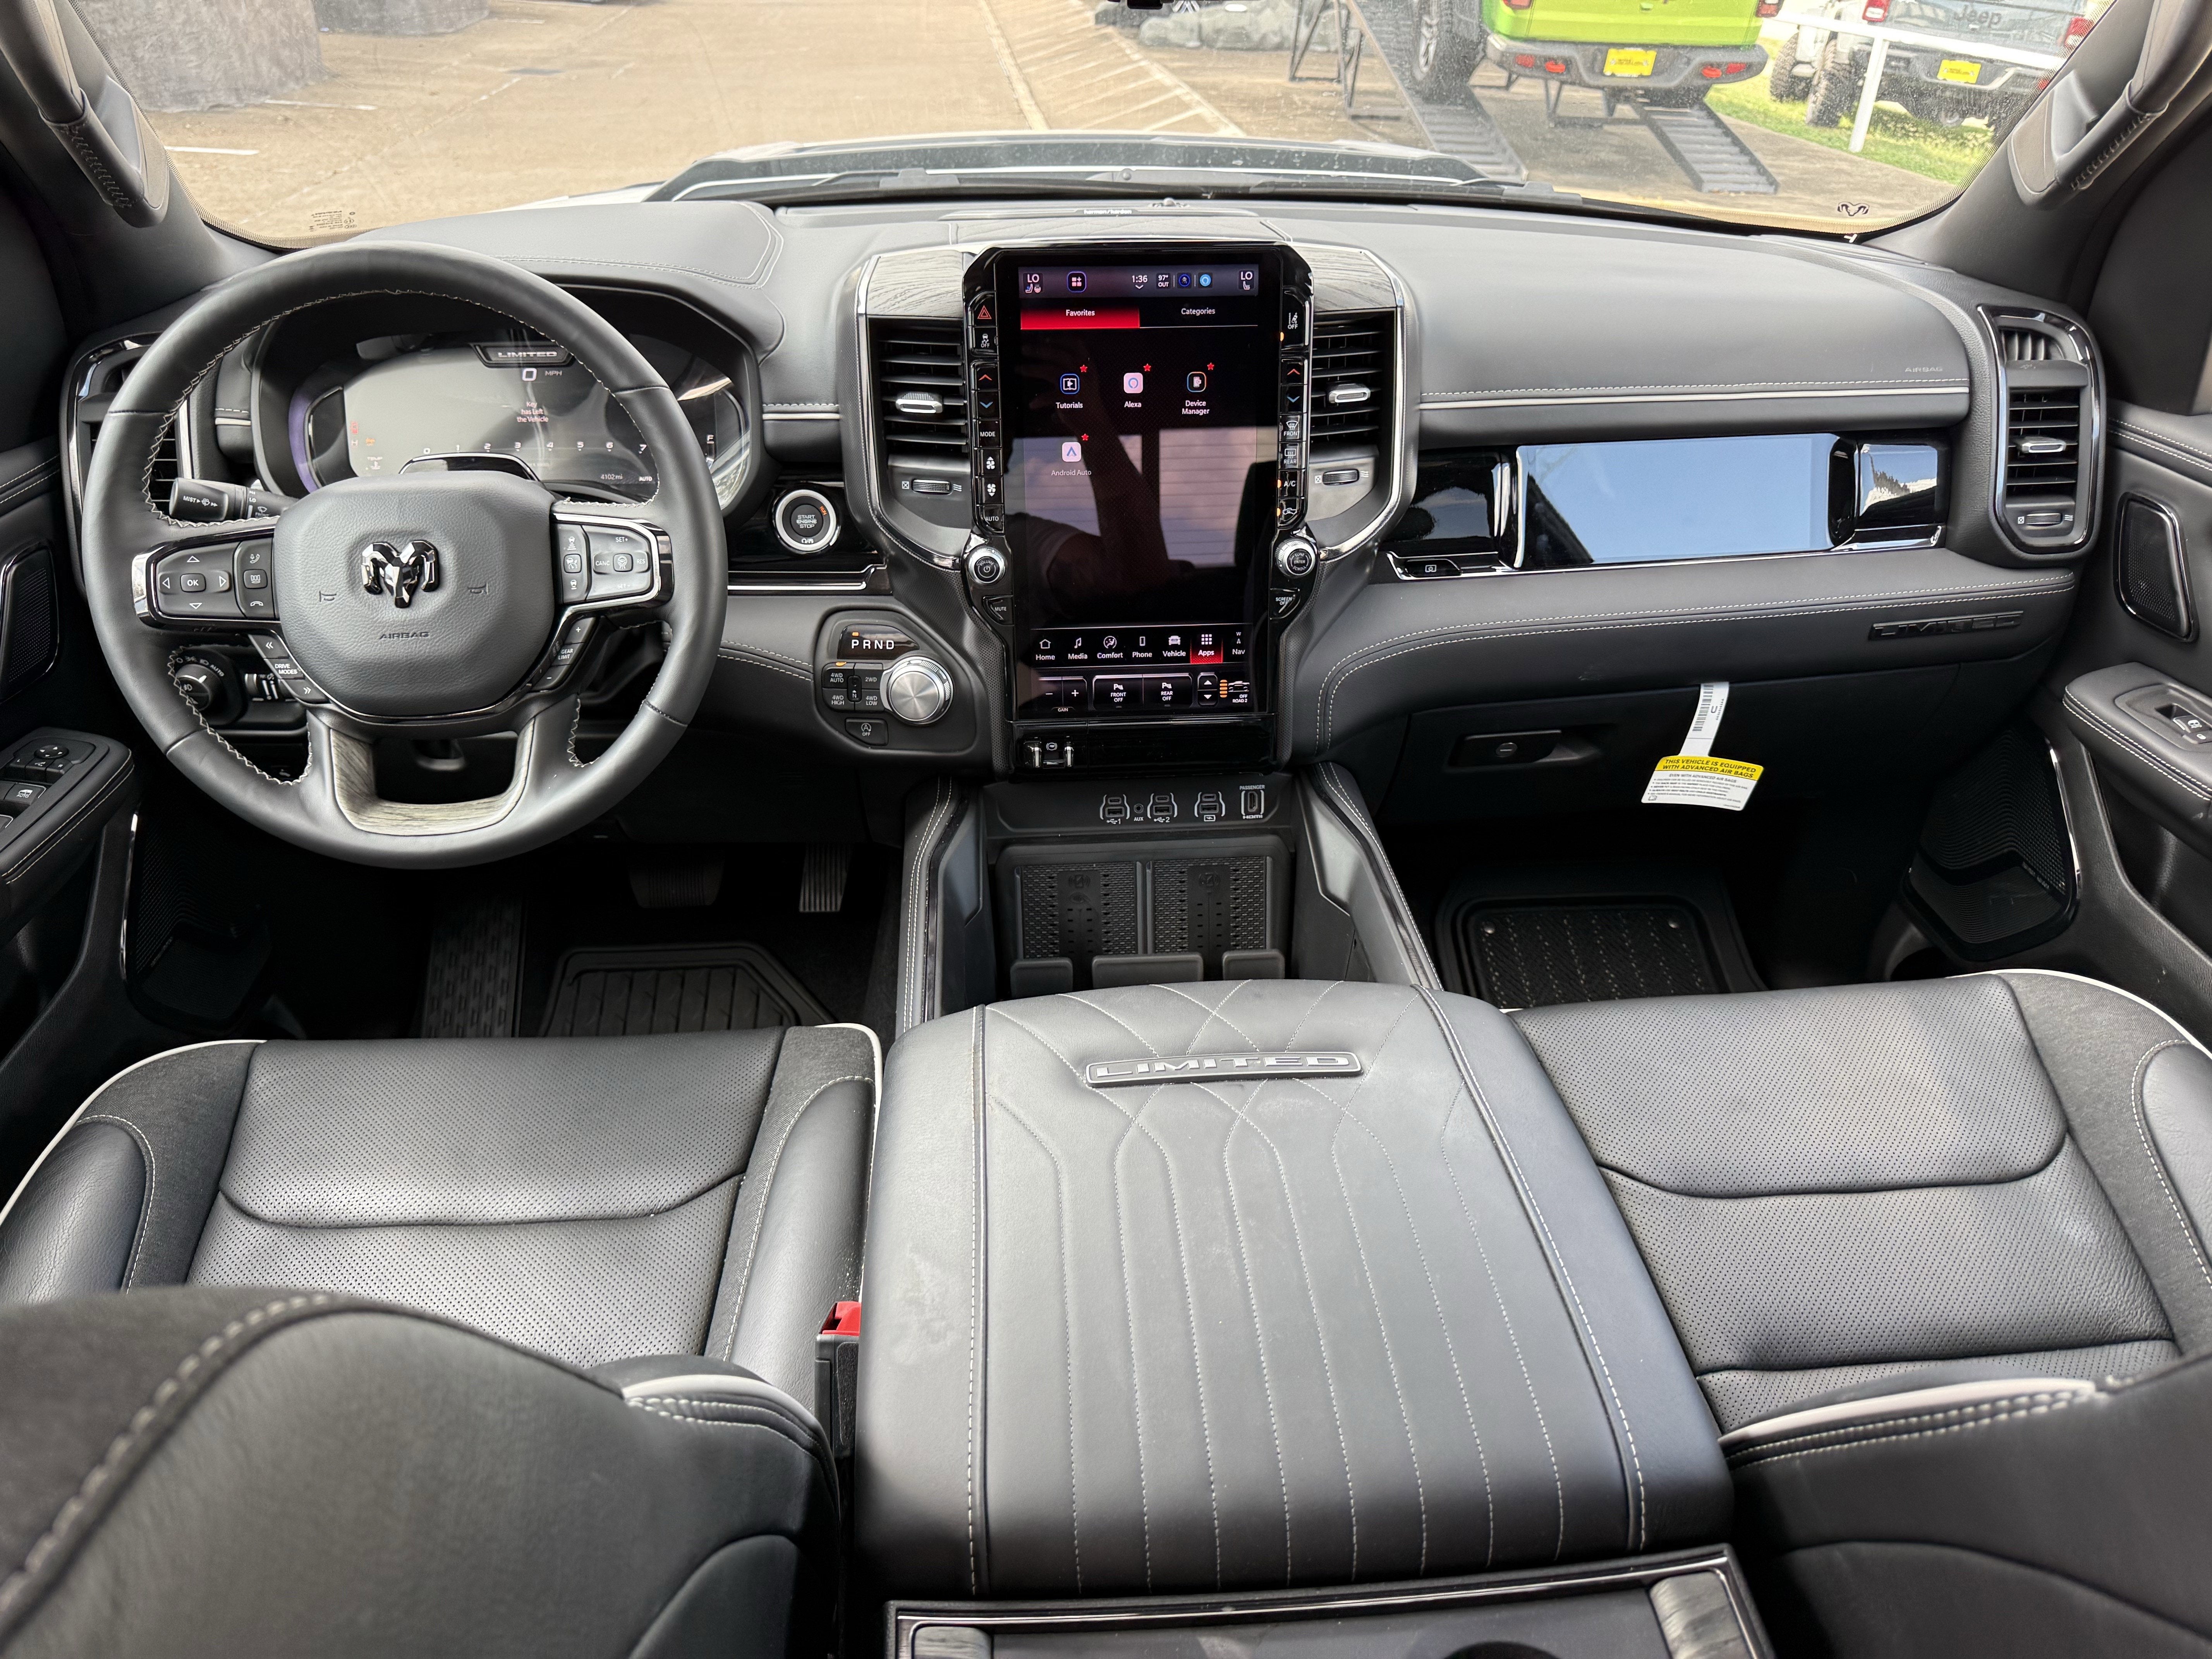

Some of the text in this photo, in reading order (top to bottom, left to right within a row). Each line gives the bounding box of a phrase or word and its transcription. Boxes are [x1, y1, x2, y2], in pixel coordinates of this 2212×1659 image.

[1953, 4, 2002, 28] Jeep
[1027, 273, 1040, 283] LO
[1240, 271, 1253, 280] LO
[1065, 309, 1095, 317] Favorites
[1181, 307, 1216, 316] Categories
[522, 368, 537, 381] 0
[210, 664, 225, 677] AUTO
[1720, 763, 1756, 773] EQUIPPED
[1096, 1056, 1350, 1078] LIMITED
